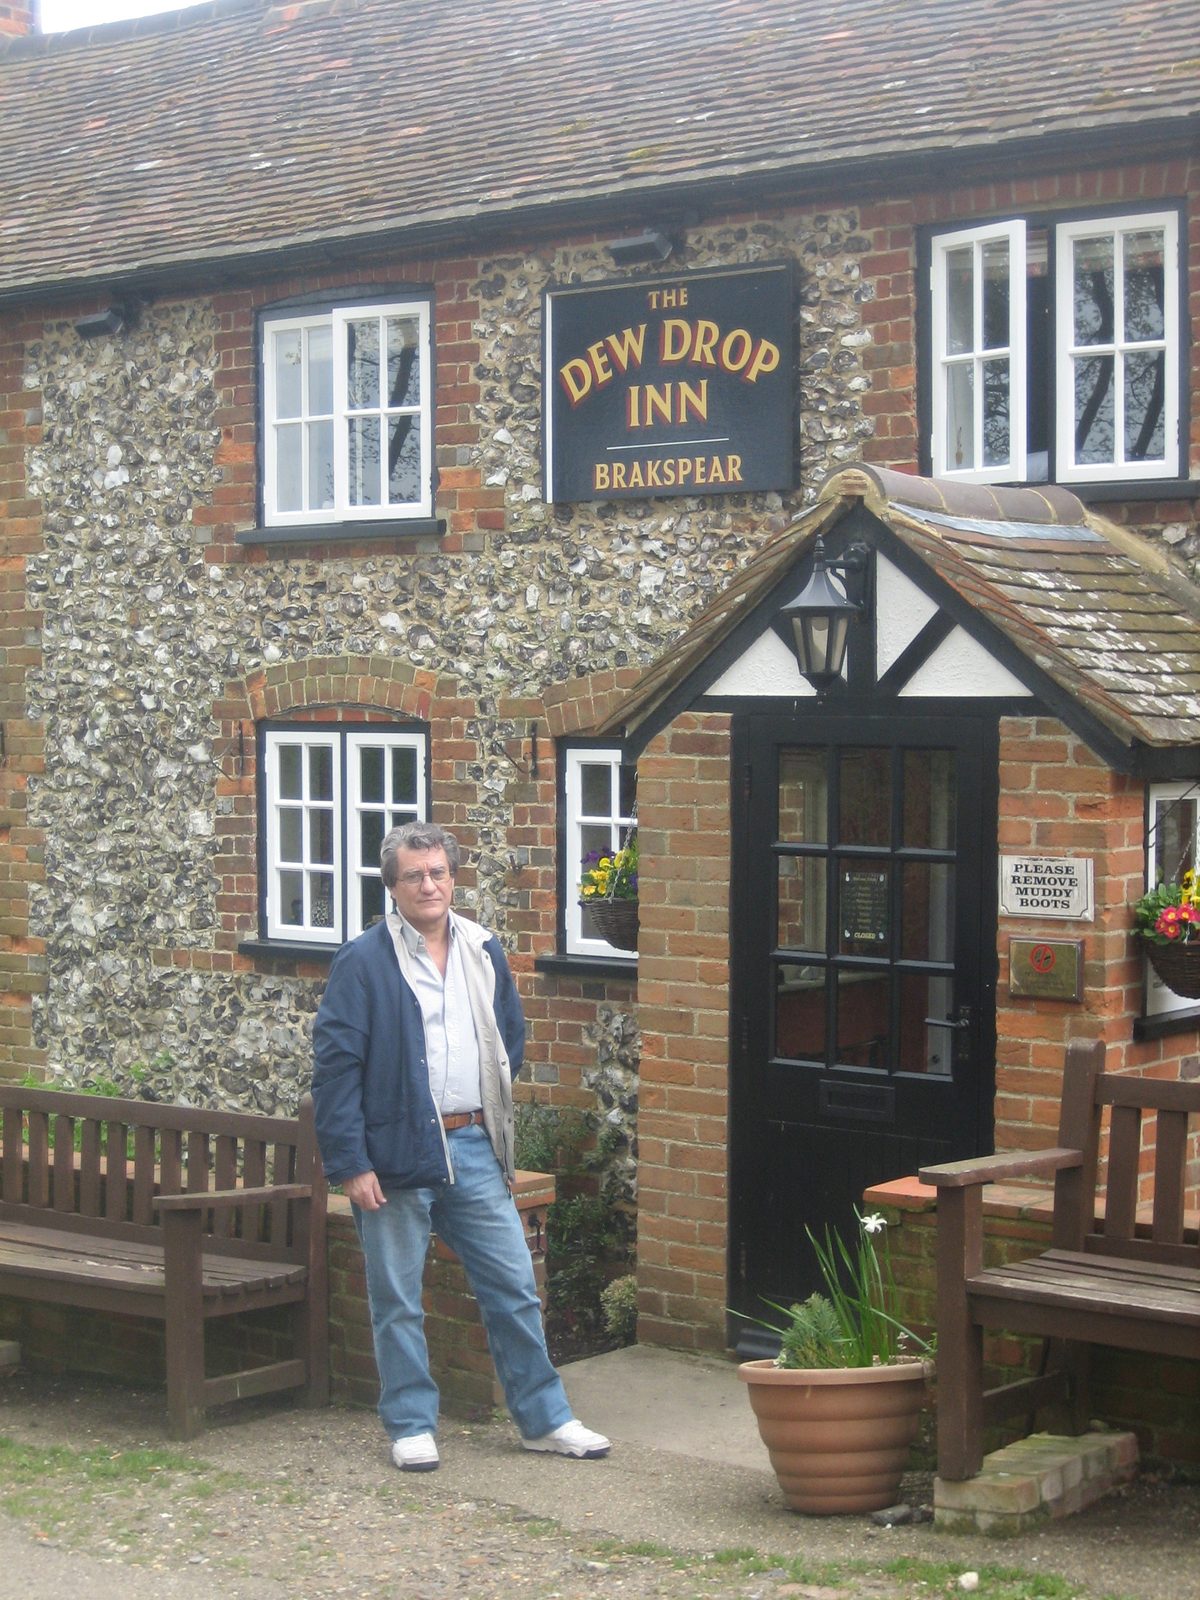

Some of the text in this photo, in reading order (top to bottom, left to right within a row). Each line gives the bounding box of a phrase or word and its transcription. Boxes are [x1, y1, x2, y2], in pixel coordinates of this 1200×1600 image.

[649, 288, 688, 309] THE
[560, 319, 780, 404] DEW DROP
[628, 379, 708, 428] INN
[595, 454, 743, 490] BRAKSPEAR
[1013, 863, 1075, 875] PLEASE
[1011, 875, 1078, 887] REMOVE
[1015, 886, 1073, 898] MUDDY
[1019, 898, 1070, 909] BOOTS
